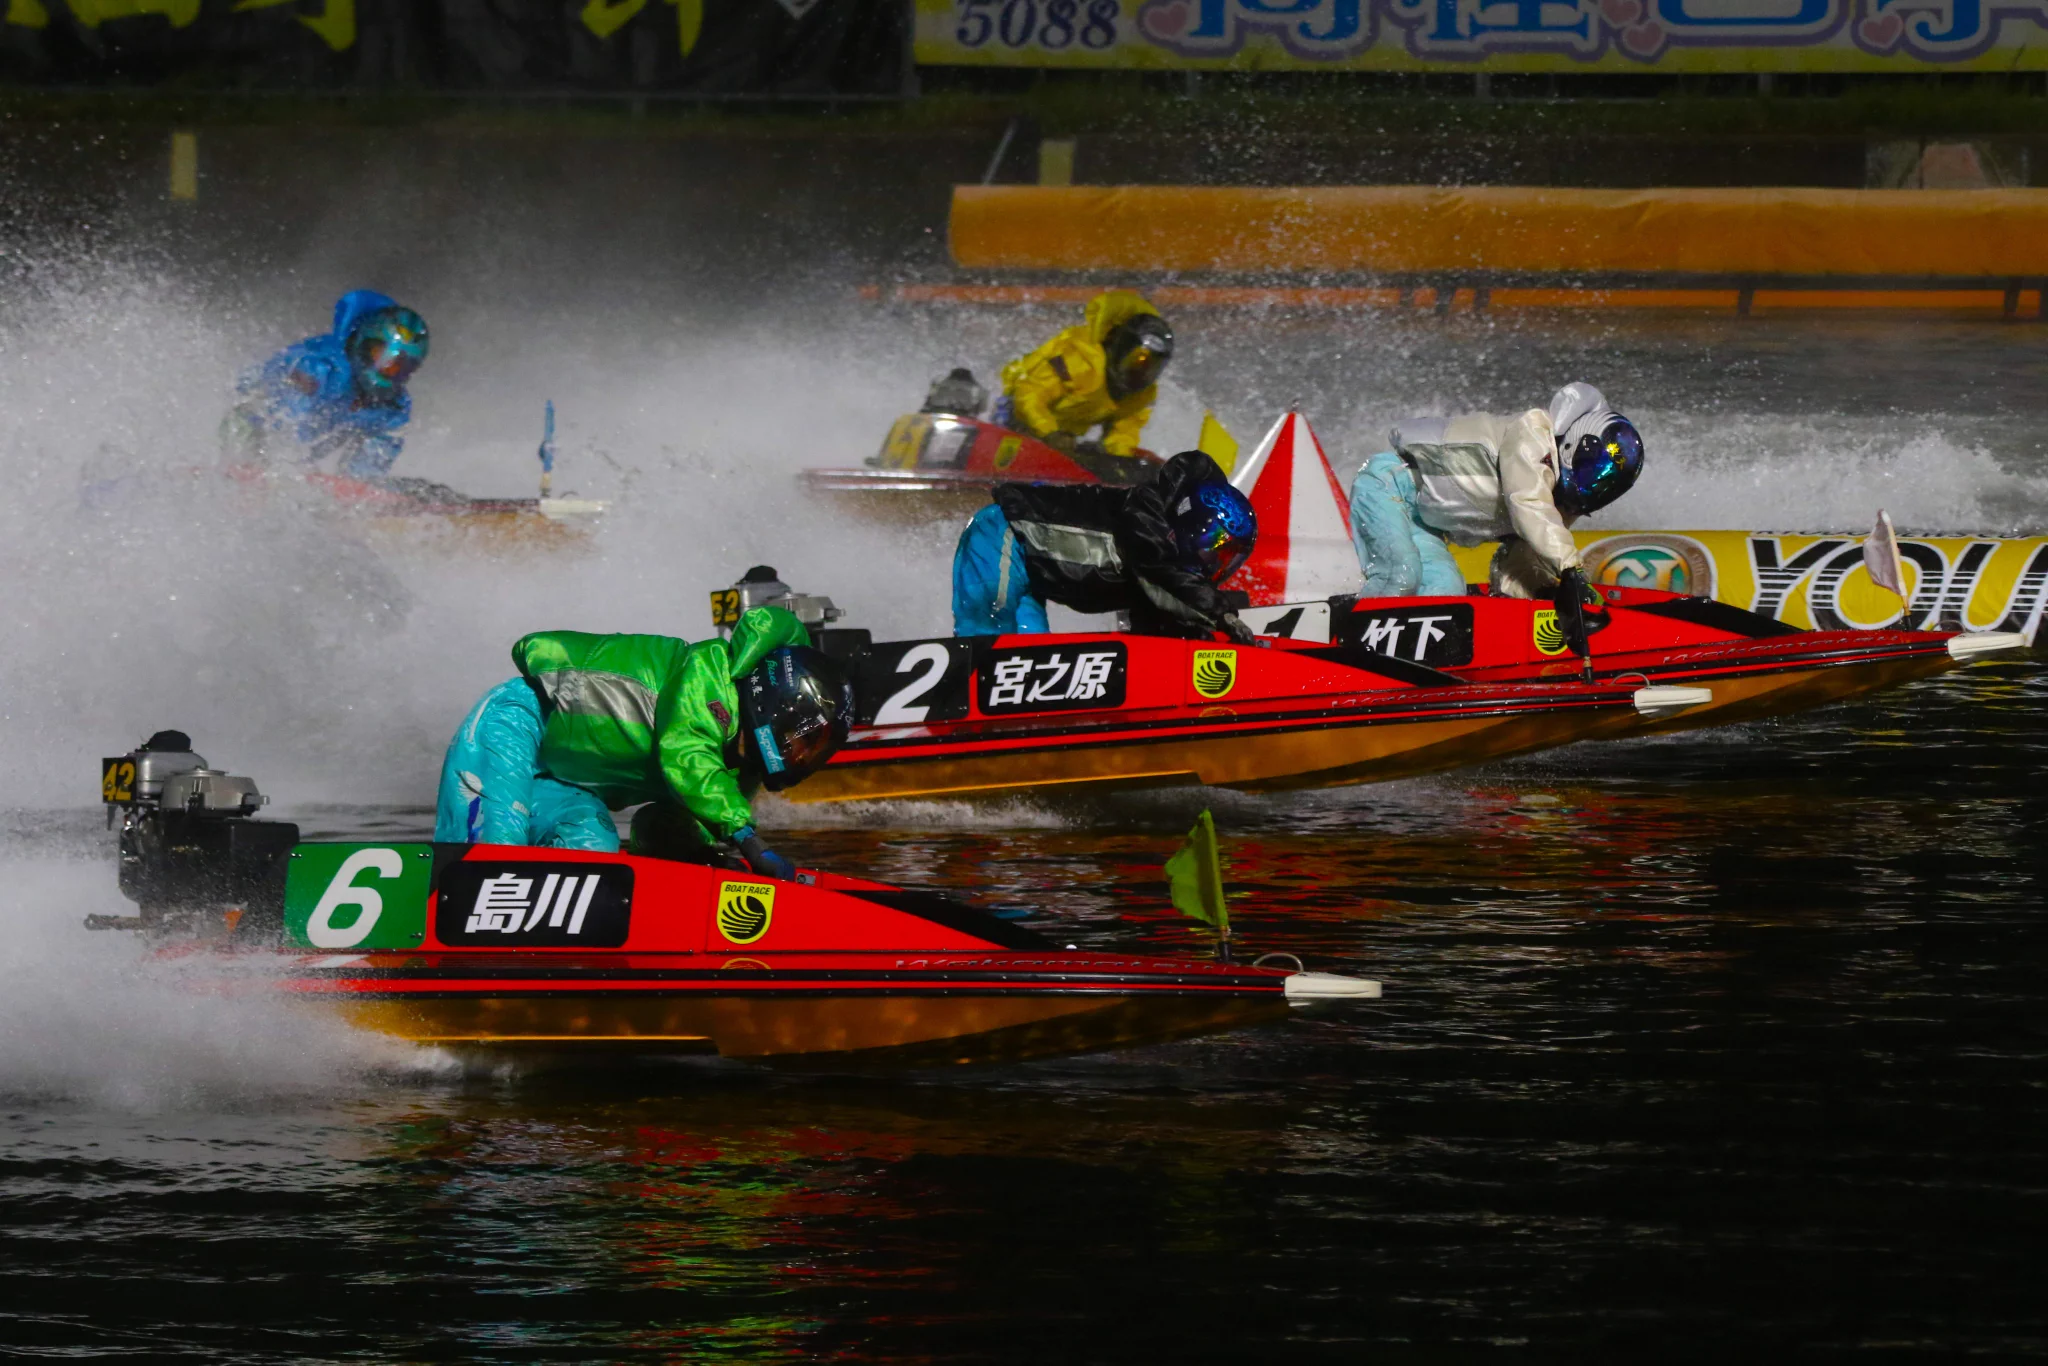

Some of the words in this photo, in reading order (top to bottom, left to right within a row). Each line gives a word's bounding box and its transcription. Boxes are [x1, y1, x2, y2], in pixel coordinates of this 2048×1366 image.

[956, 0, 1120, 49] 5088
[711, 589, 739, 625] 52
[1748, 537, 2048, 640] YOU
[1263, 607, 1305, 639] 1
[1360, 615, 1453, 661] 竹下
[873, 642, 950, 726] 2
[988, 651, 1117, 707] 宮之原
[758, 727, 782, 773] Supreme
[103, 761, 136, 801] 42
[306, 848, 404, 949] 6
[464, 872, 602, 935] 島川
[725, 884, 747, 893] BOAT
[748, 886, 771, 895] RACE
